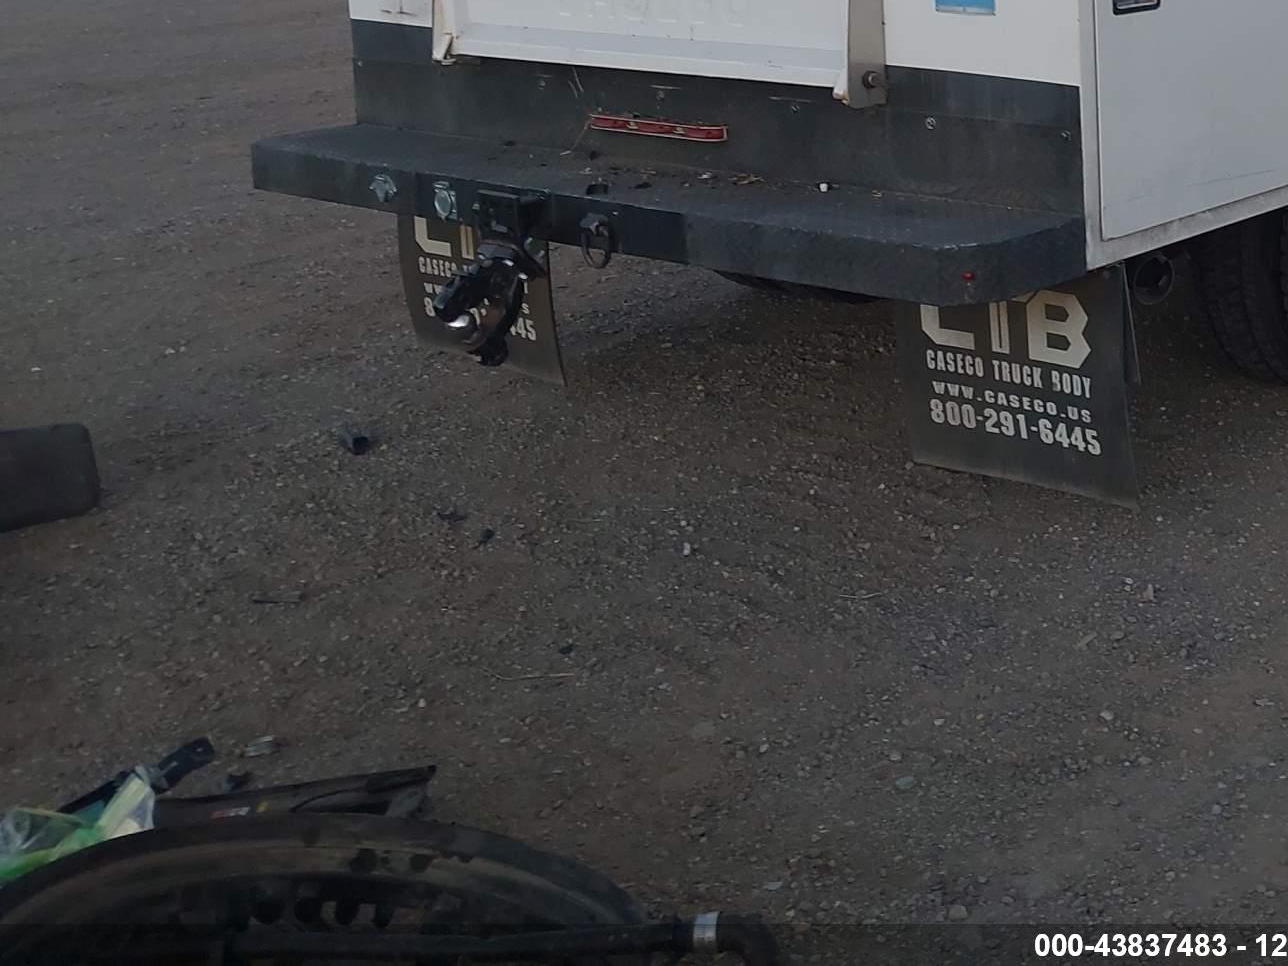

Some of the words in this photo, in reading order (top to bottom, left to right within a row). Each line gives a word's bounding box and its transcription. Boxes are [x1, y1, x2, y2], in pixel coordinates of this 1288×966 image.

[926, 349, 985, 378] CASECO
[991, 359, 1044, 388] TRUCK
[1051, 370, 1092, 399] BODY
[929, 398, 1102, 455] 800-291-6445
